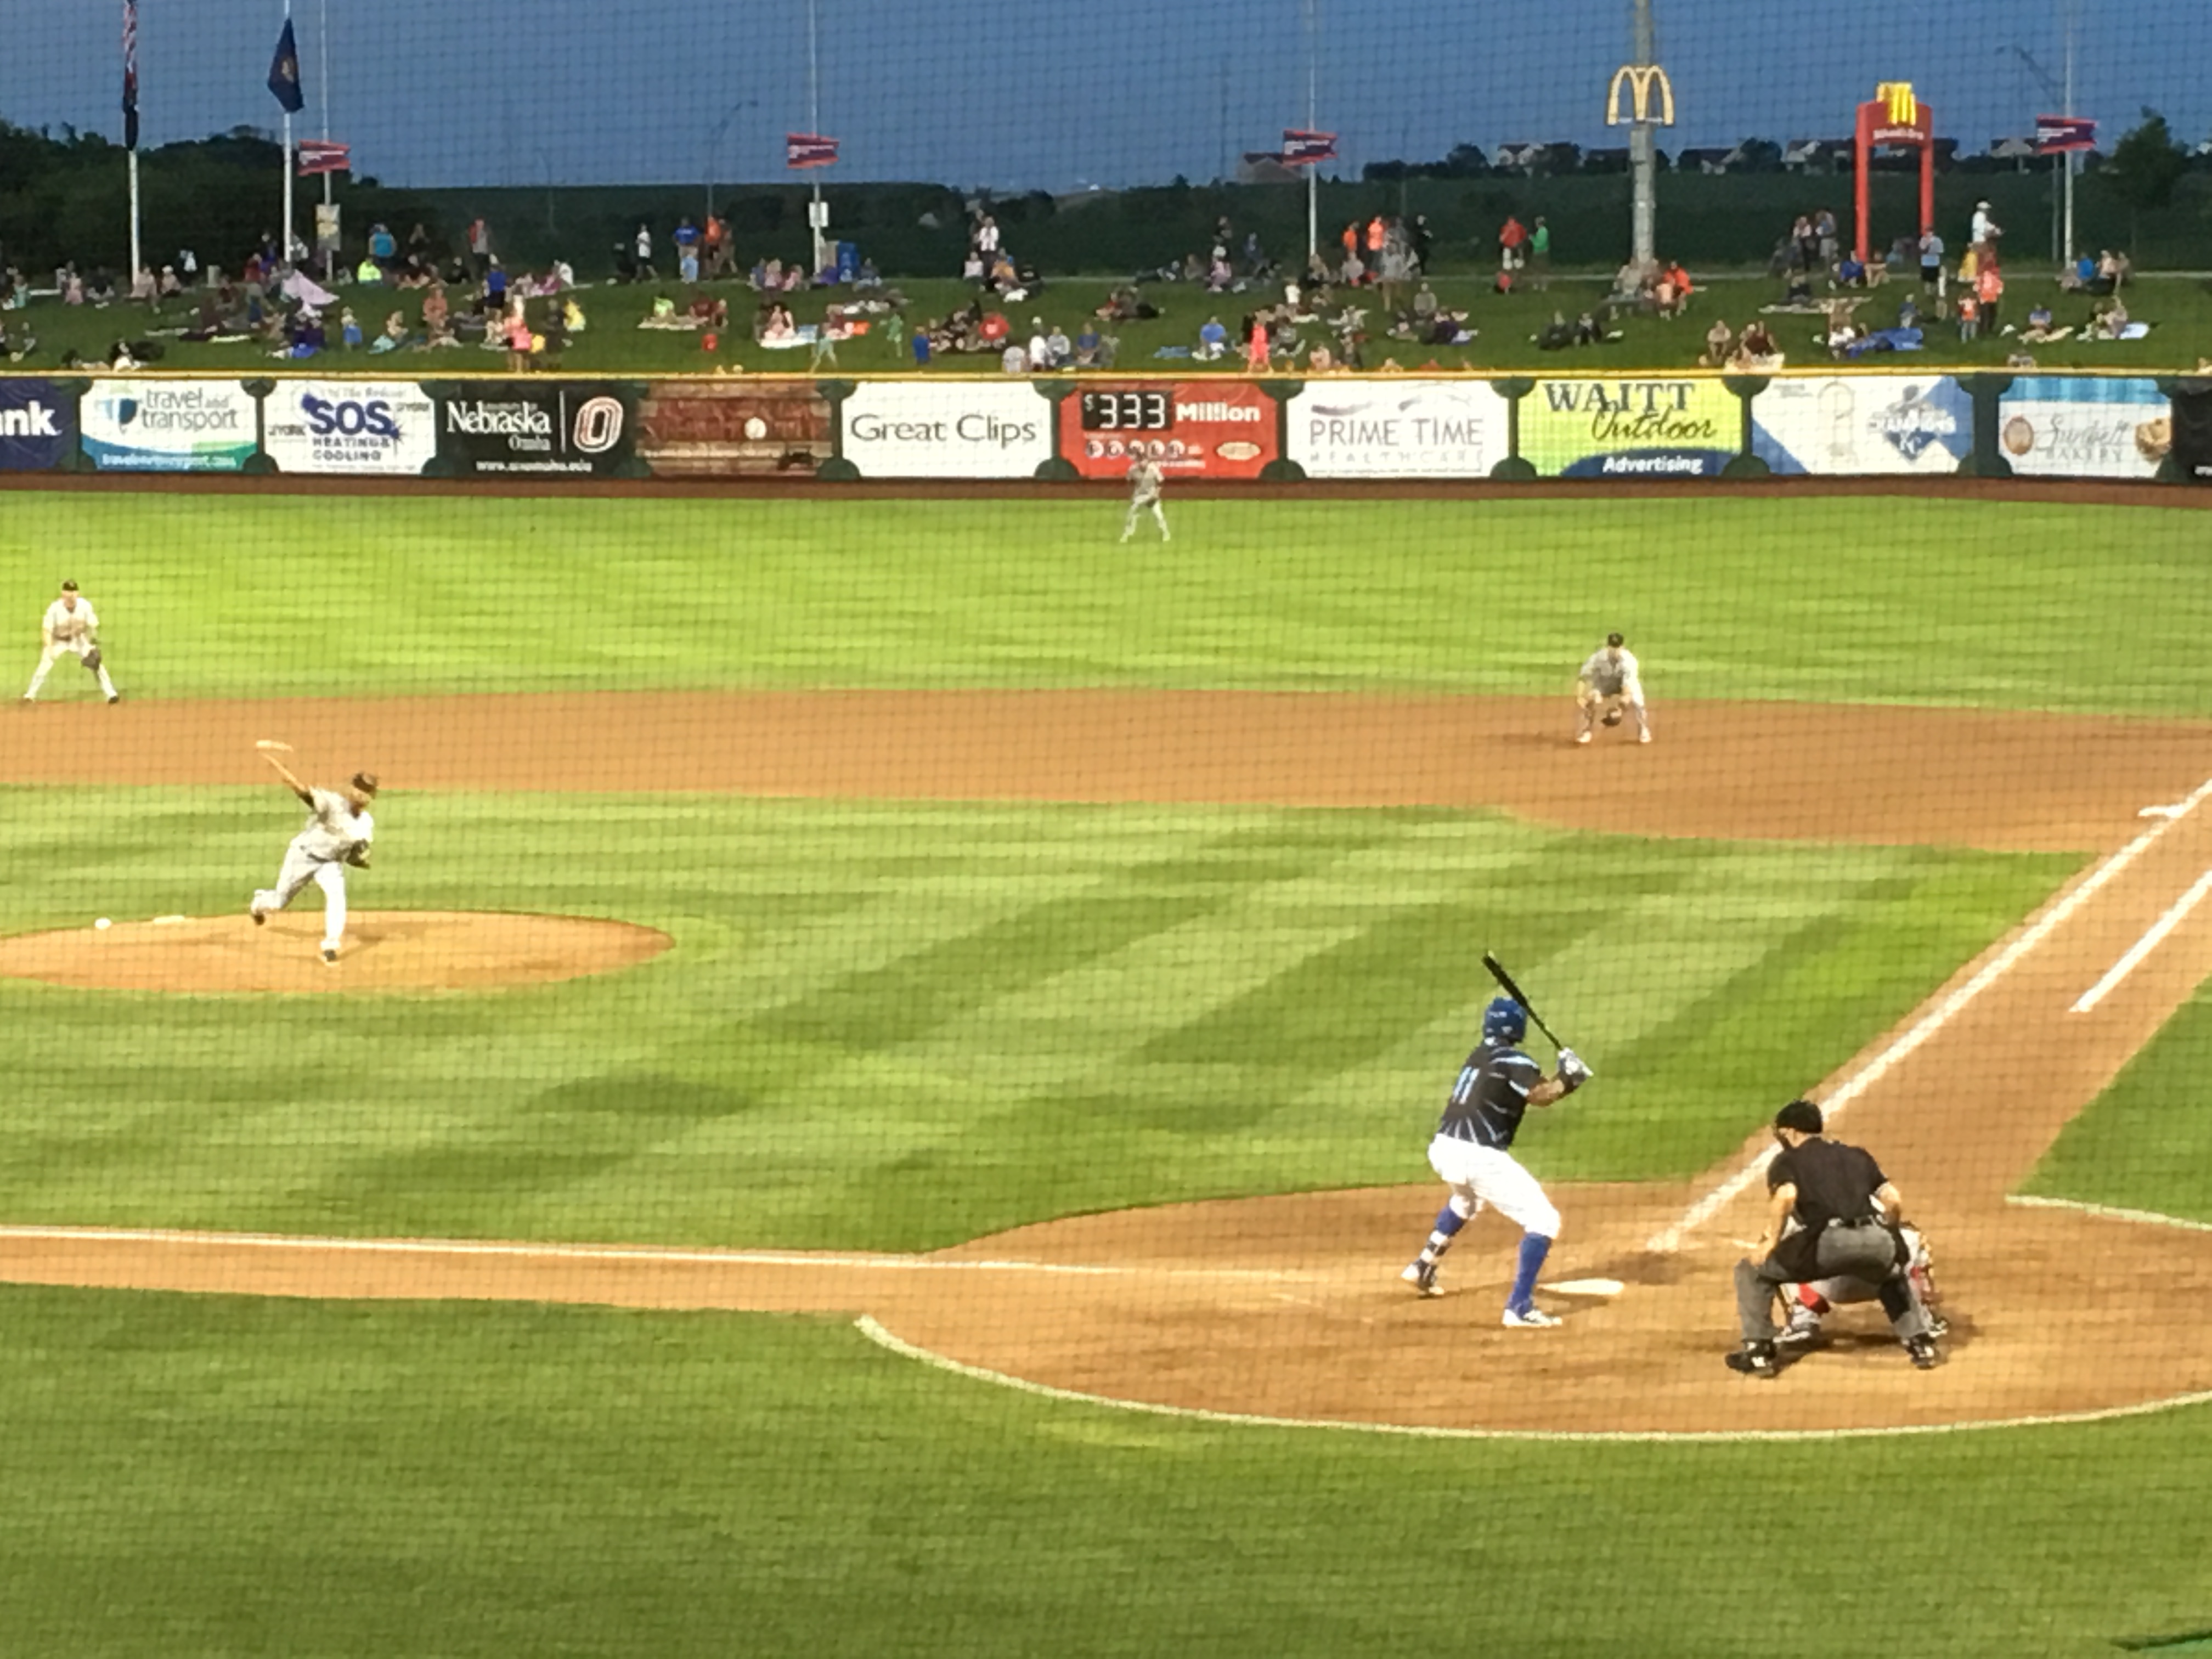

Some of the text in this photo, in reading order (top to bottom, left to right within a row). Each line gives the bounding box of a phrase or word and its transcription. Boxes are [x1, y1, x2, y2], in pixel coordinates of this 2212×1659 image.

[146, 388, 202, 408] travel
[1544, 382, 1695, 411] WAITT
[0, 400, 62, 436] nk
[143, 408, 239, 431] transport
[309, 400, 396, 436] SOS
[446, 400, 552, 434] Nebraska
[1175, 403, 1260, 422] Million
[1592, 400, 1718, 441] Outdoor
[851, 414, 1037, 449] Great Clips
[1310, 417, 1483, 446] PRIME TIME
[1602, 455, 1703, 475] Advertising
